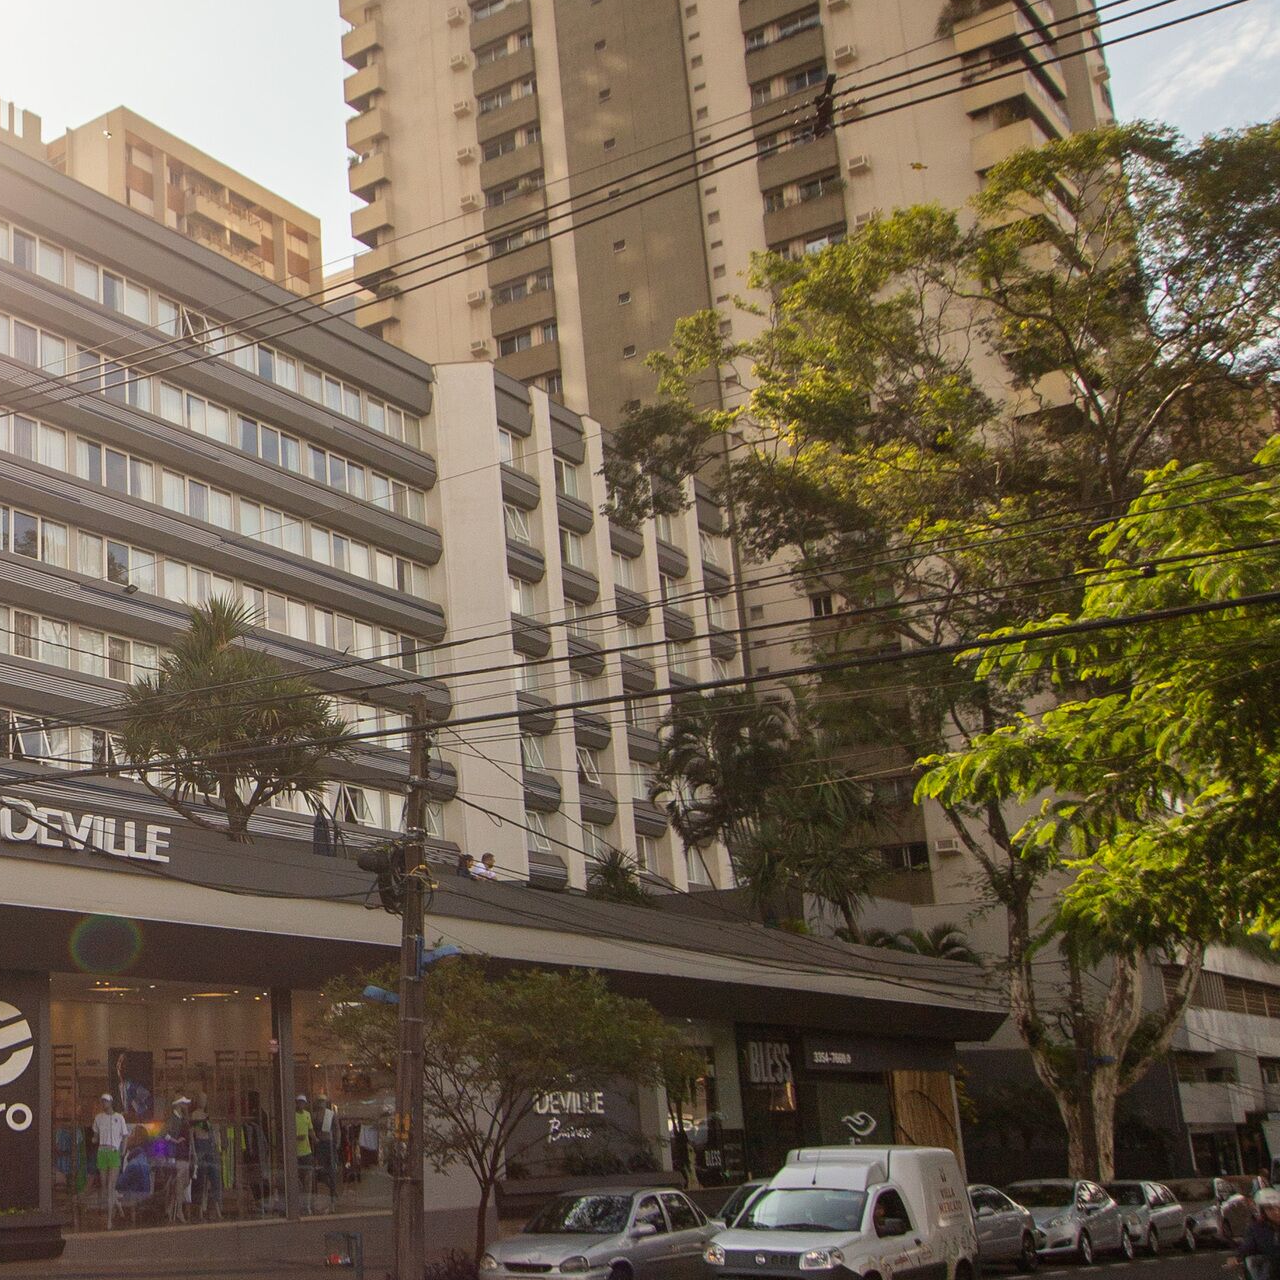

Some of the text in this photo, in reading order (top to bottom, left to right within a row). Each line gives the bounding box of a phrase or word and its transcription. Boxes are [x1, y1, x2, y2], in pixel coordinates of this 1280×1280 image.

[0, 795, 171, 863] DEVILLE
[749, 1041, 793, 1084] BLESS
[532, 1087, 605, 1115] DEVILLE
[705, 1150, 721, 1167] BLESS
